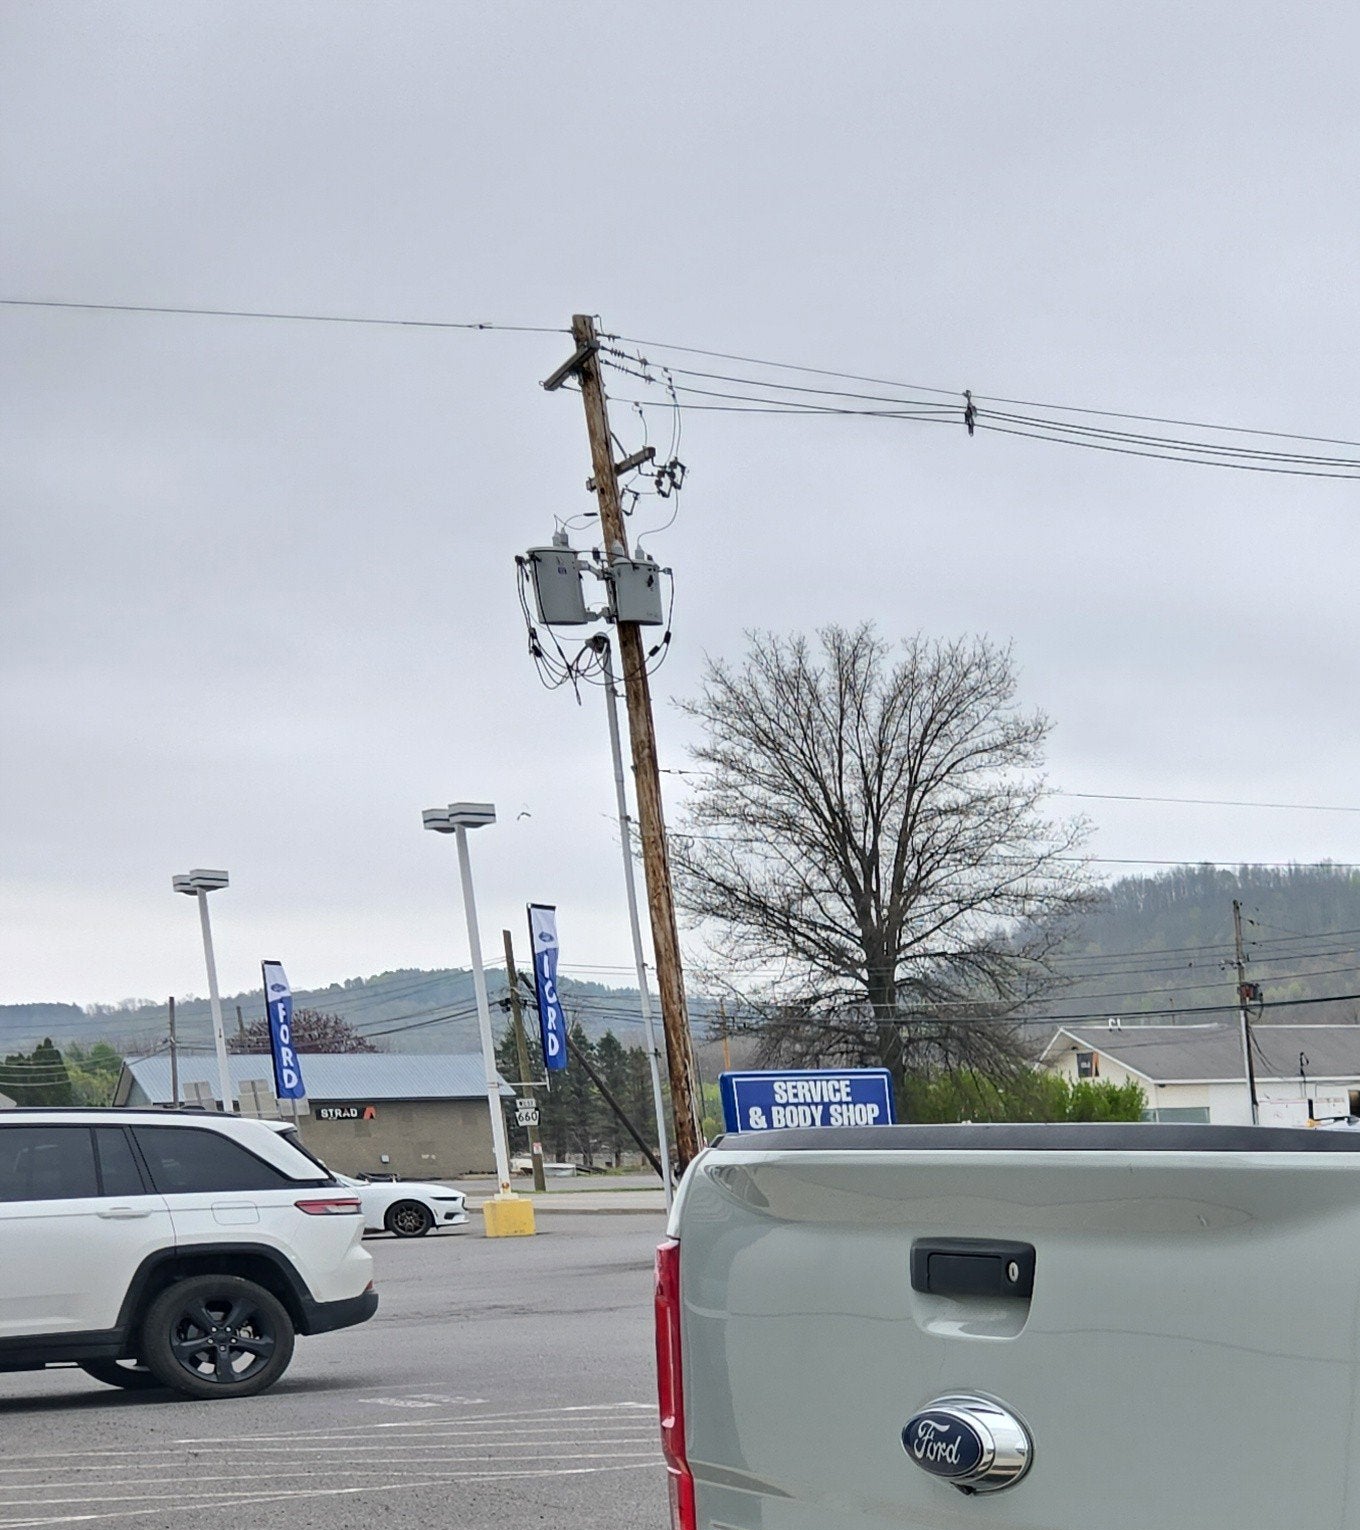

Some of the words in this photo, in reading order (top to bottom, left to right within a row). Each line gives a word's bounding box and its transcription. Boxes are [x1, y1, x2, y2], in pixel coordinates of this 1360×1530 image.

[277, 1002, 299, 1089] FORD
[773, 1080, 853, 1104] SERVICE
[321, 1108, 358, 1118] STRAD
[518, 1111, 538, 1122] 660
[749, 1106, 767, 1130] &
[771, 1105, 823, 1128] BODY
[829, 1103, 880, 1126] SHOP
[914, 1420, 961, 1465] Ford
